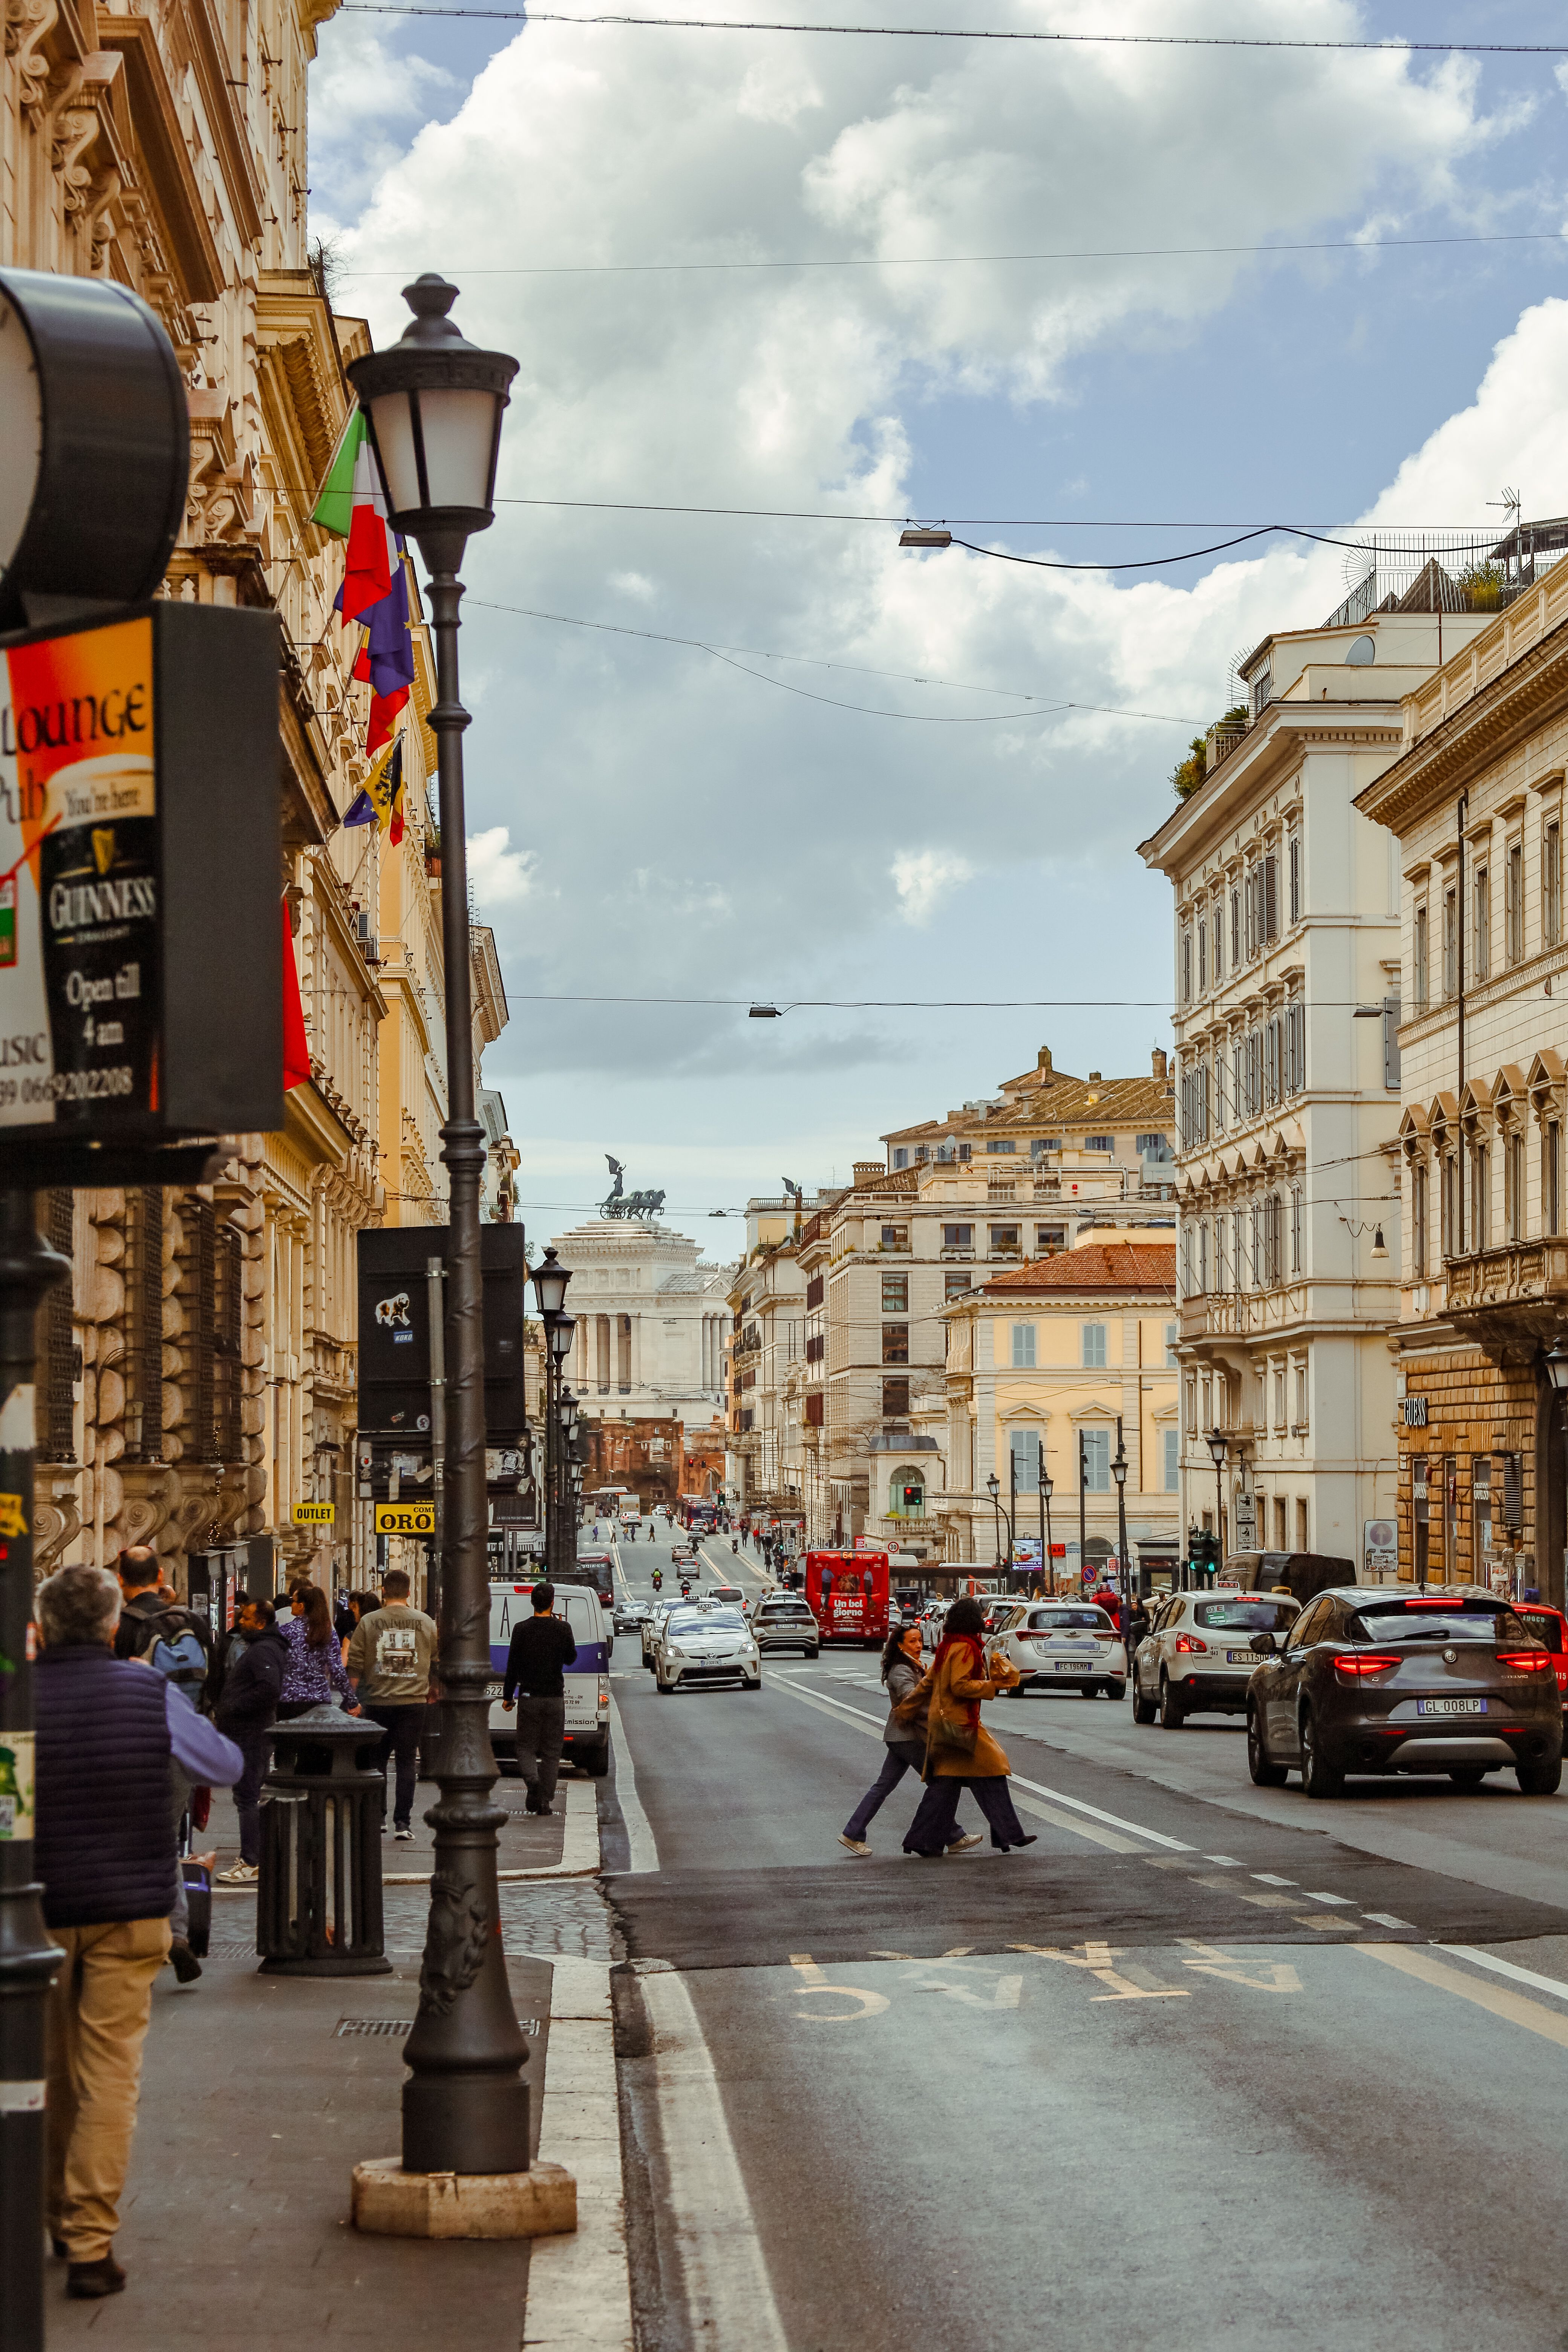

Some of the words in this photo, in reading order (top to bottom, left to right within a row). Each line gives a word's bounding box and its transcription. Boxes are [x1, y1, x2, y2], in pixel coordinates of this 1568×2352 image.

[49, 876, 156, 929] GUINNESS
[66, 971, 113, 1012] Open
[115, 962, 141, 999] till
[83, 1016, 95, 1047] 4
[96, 1021, 124, 1046] am
[1404, 1397, 1425, 1426] GUESS
[1413, 1482, 1426, 1499] GUESS
[1474, 1482, 1488, 1500] GUESS
[297, 1508, 331, 1519] OUTLET
[380, 1514, 431, 1530] ORO
[834, 1599, 847, 1608] Un
[849, 1599, 863, 1608] bel
[833, 1608, 863, 1618] giorno
[1426, 1701, 1439, 1712] GL
[1444, 1700, 1479, 1712] 008LP
